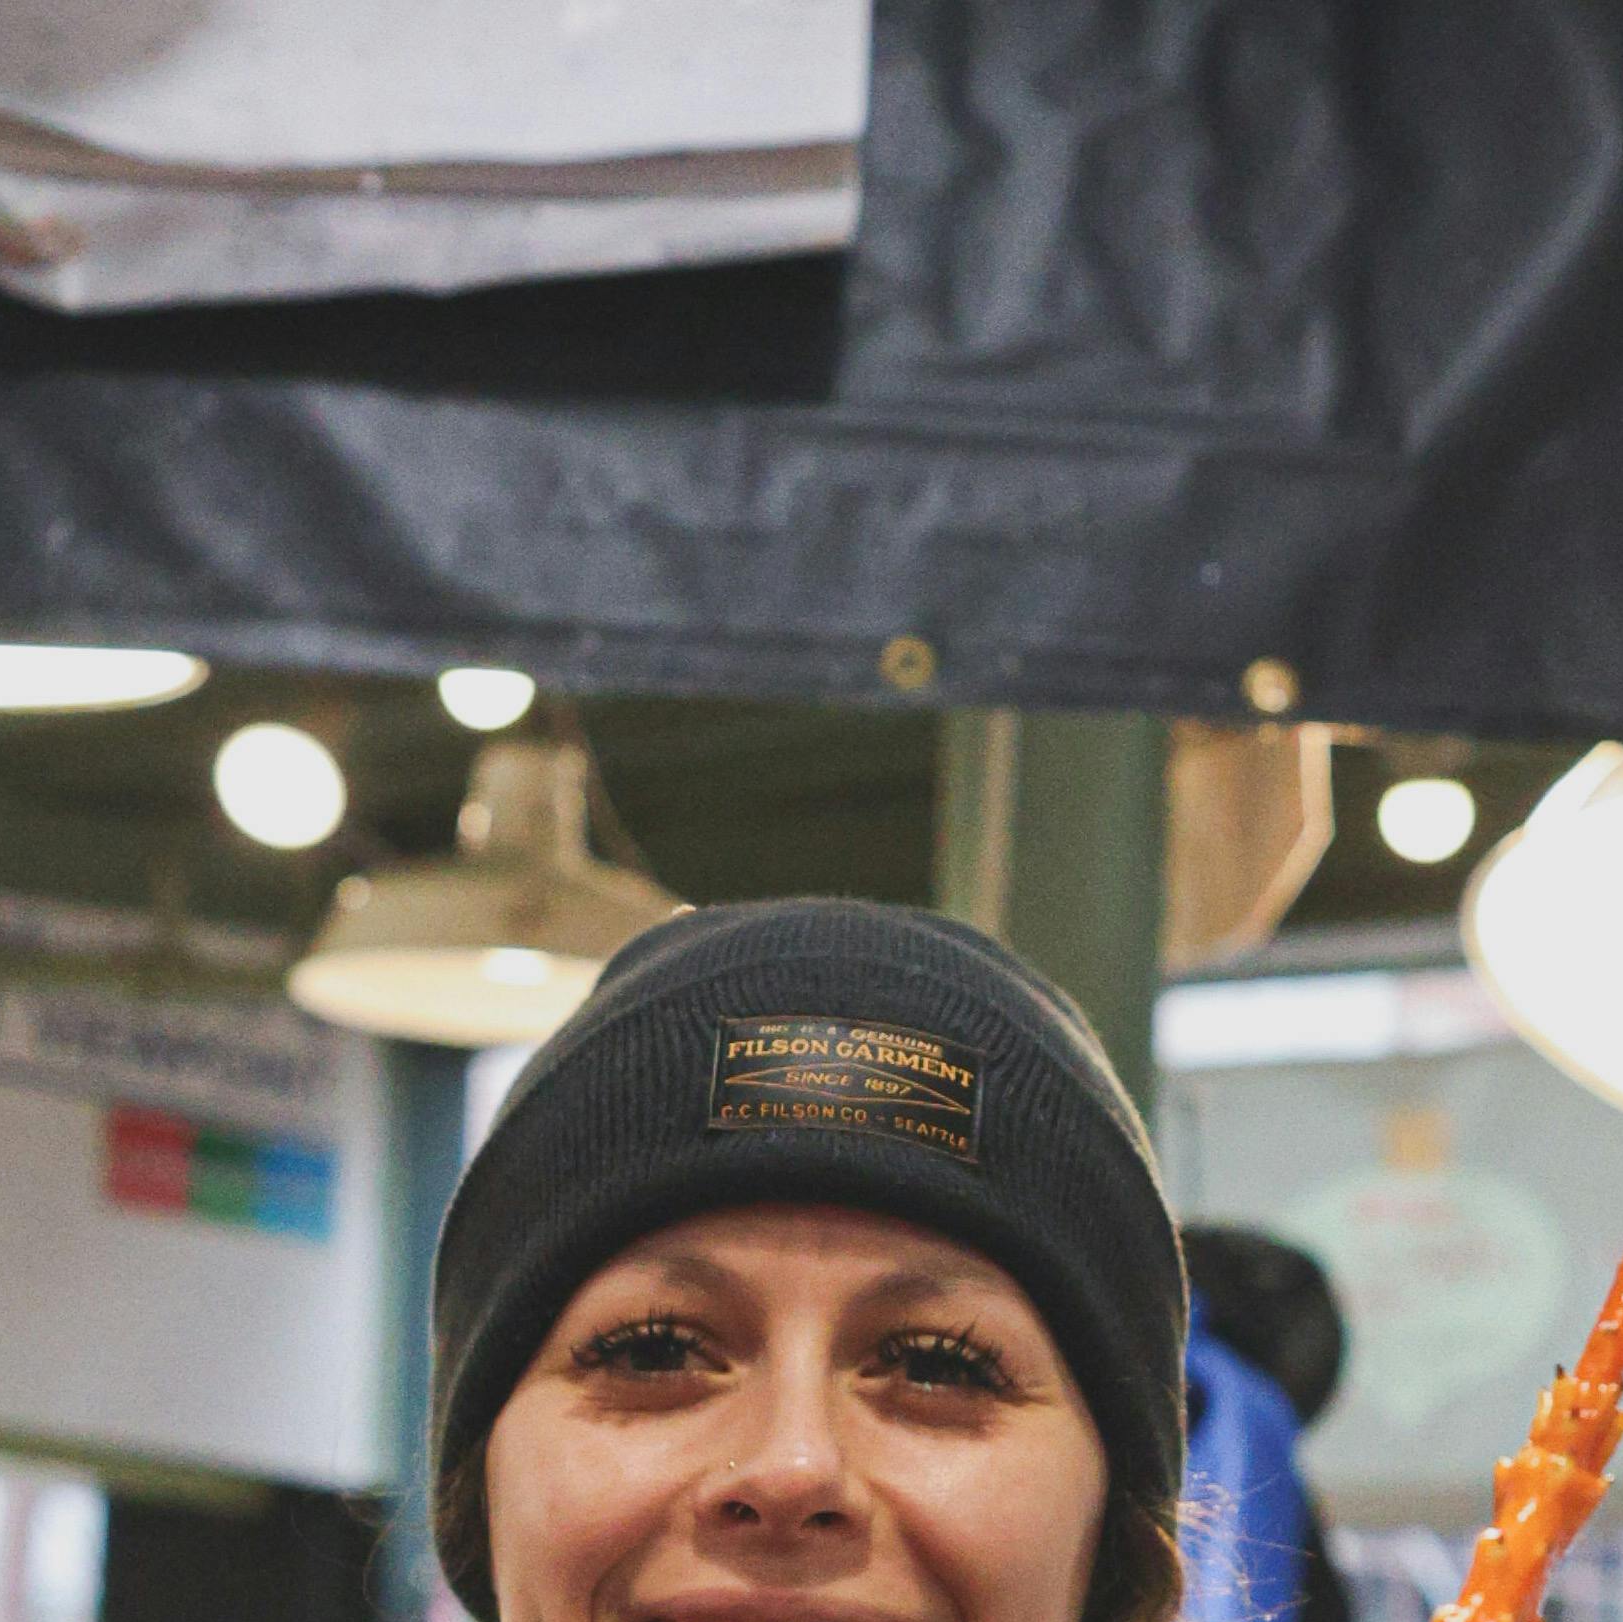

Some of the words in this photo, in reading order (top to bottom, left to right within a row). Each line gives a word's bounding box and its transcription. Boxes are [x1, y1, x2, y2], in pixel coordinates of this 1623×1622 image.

[850, 1028, 943, 1057] GENUINE
[727, 1038, 830, 1059] FILSON
[836, 1041, 975, 1089] GARMENT
[785, 1071, 853, 1088] SINCE
[864, 1078, 912, 1096] 1897
[760, 1102, 835, 1119] FILSON
[894, 1115, 969, 1151] SEATTLE
